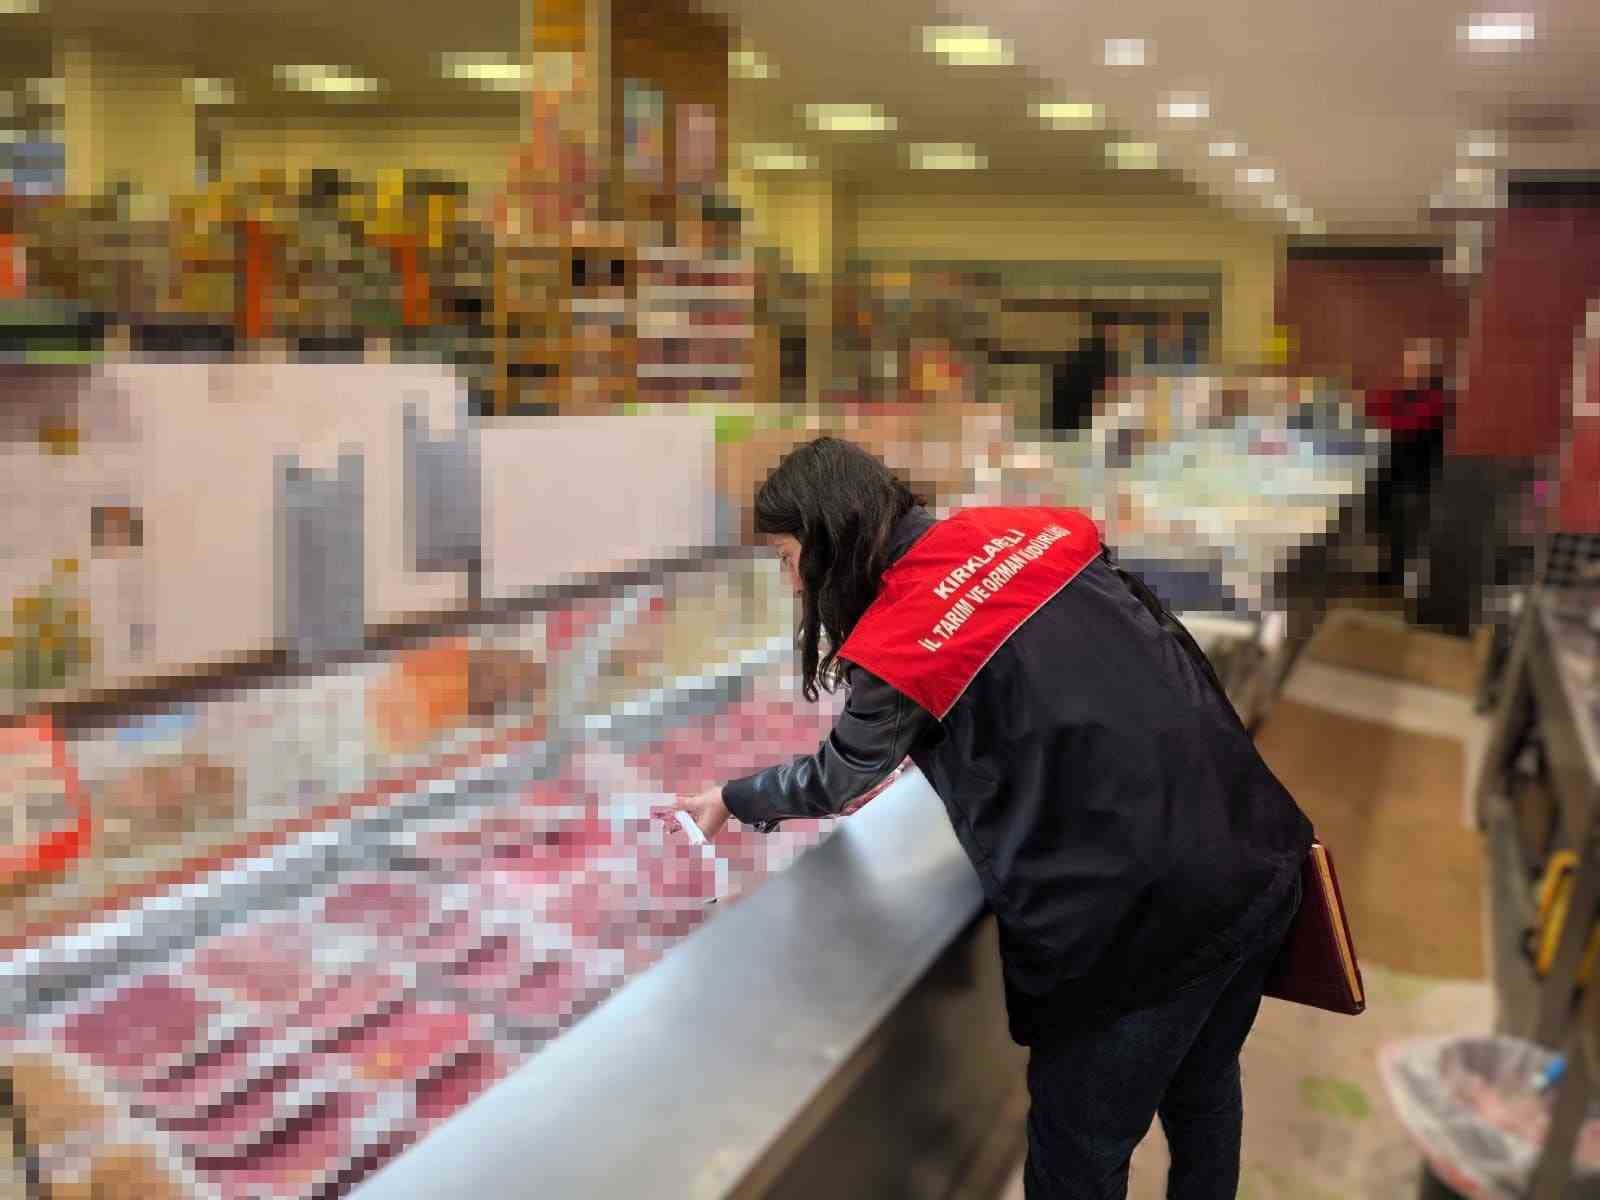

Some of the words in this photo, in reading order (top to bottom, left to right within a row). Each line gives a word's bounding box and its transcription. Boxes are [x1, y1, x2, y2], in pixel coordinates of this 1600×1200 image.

[932, 597, 976, 641] TARIM
[965, 585, 992, 605] VE
[982, 552, 1028, 593] ORMAN
